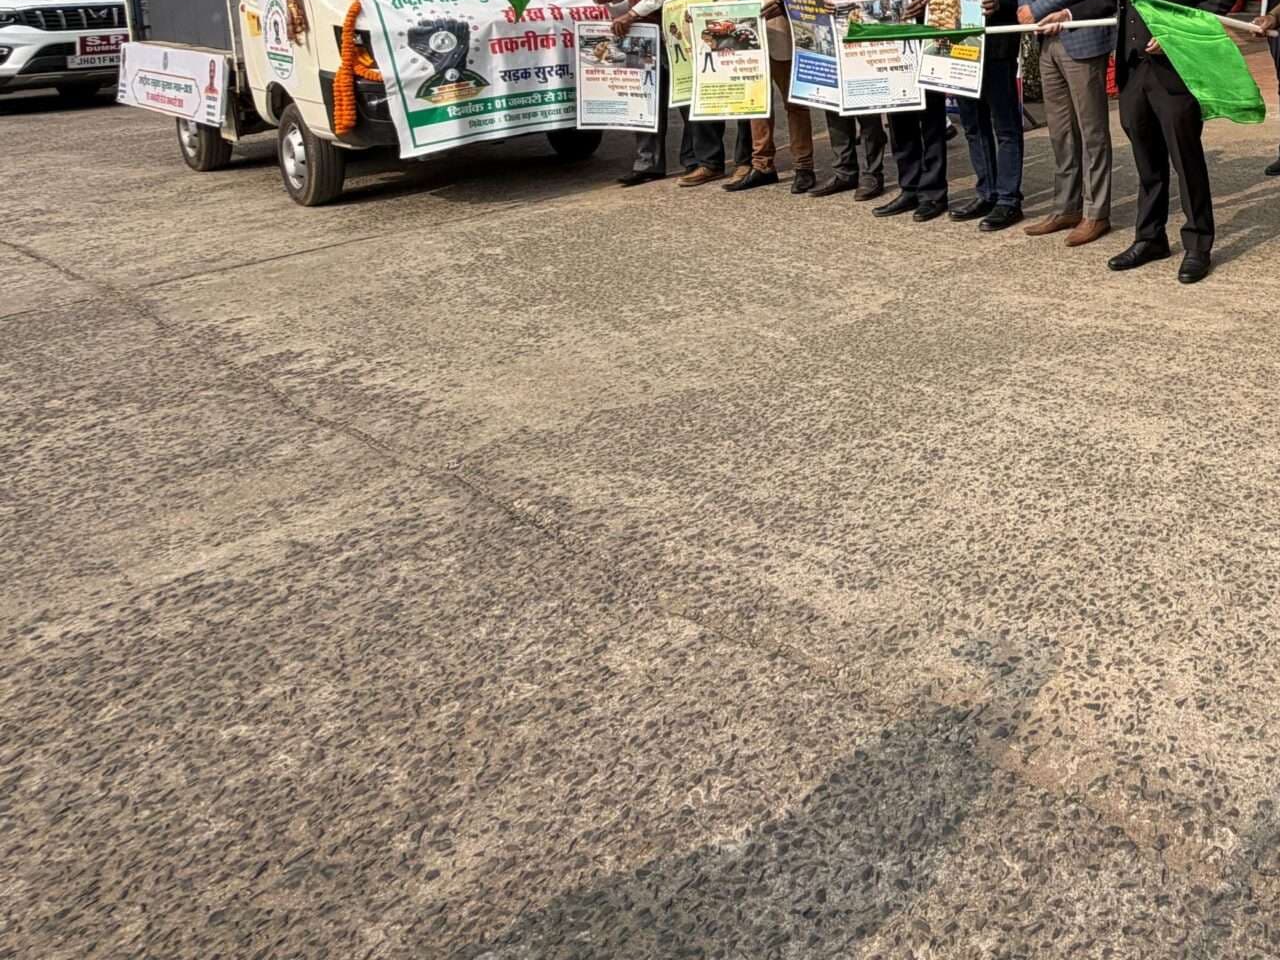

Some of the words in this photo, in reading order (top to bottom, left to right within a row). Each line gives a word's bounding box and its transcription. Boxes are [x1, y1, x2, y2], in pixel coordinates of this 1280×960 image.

[547, 3, 564, 20] से
[488, 30, 557, 54] तकनीक
[560, 28, 575, 48] से
[499, 68, 532, 83] सड़क
[447, 103, 485, 117] दिनांक
[495, 99, 507, 109] 01
